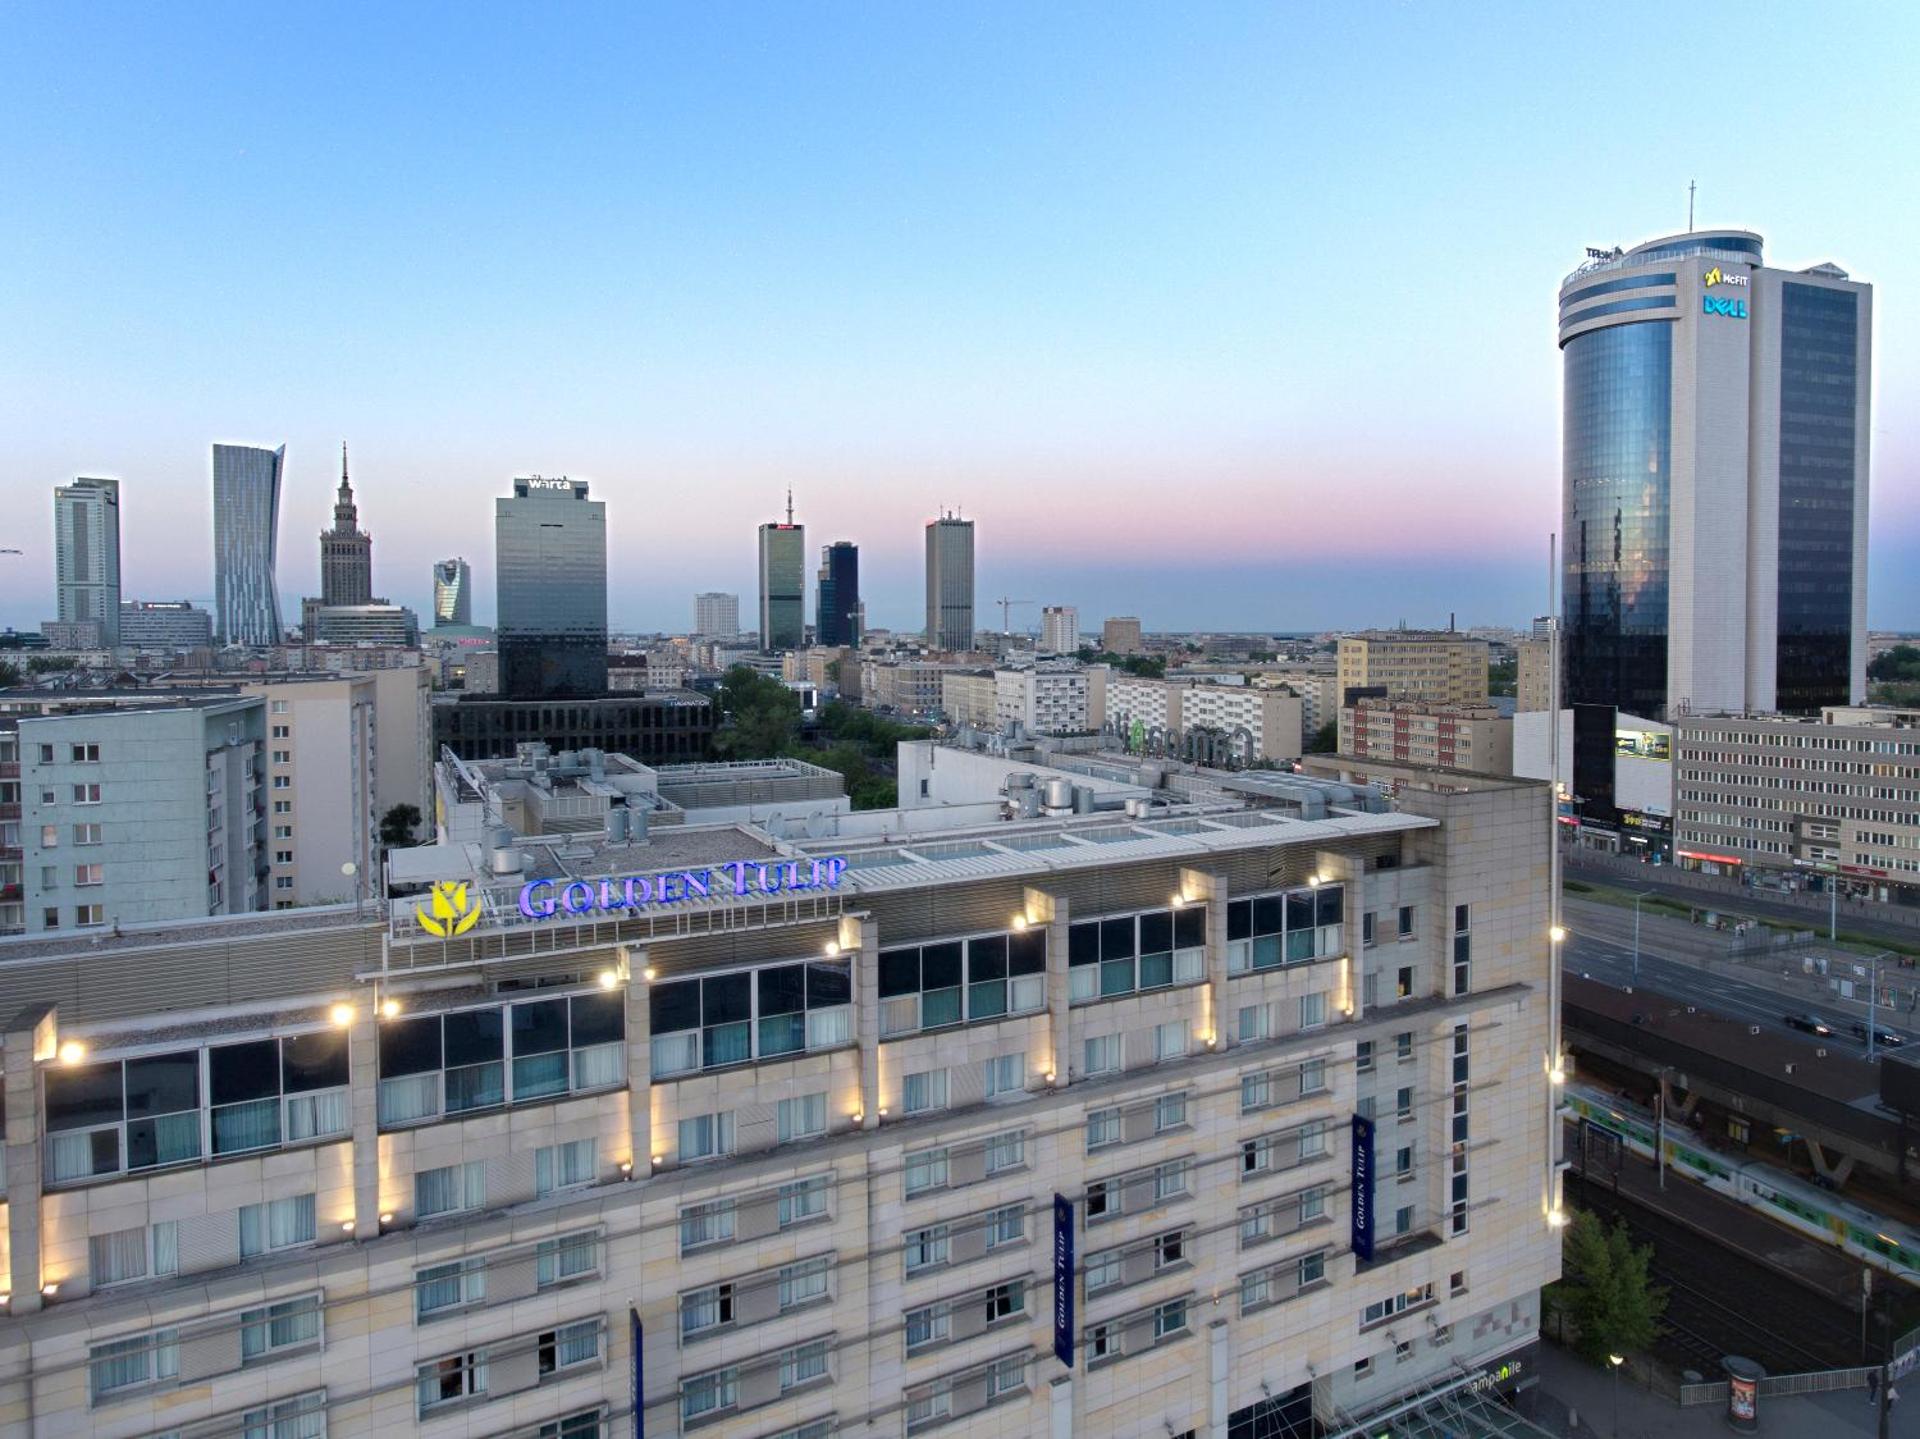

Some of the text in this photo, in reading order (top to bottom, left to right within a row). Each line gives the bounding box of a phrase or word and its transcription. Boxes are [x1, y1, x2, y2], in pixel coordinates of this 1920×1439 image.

[1703, 295, 1748, 319] DELL
[519, 856, 847, 918] GOLDEN TULIP
[1356, 1145, 1366, 1230] GOLDEN TULIP
